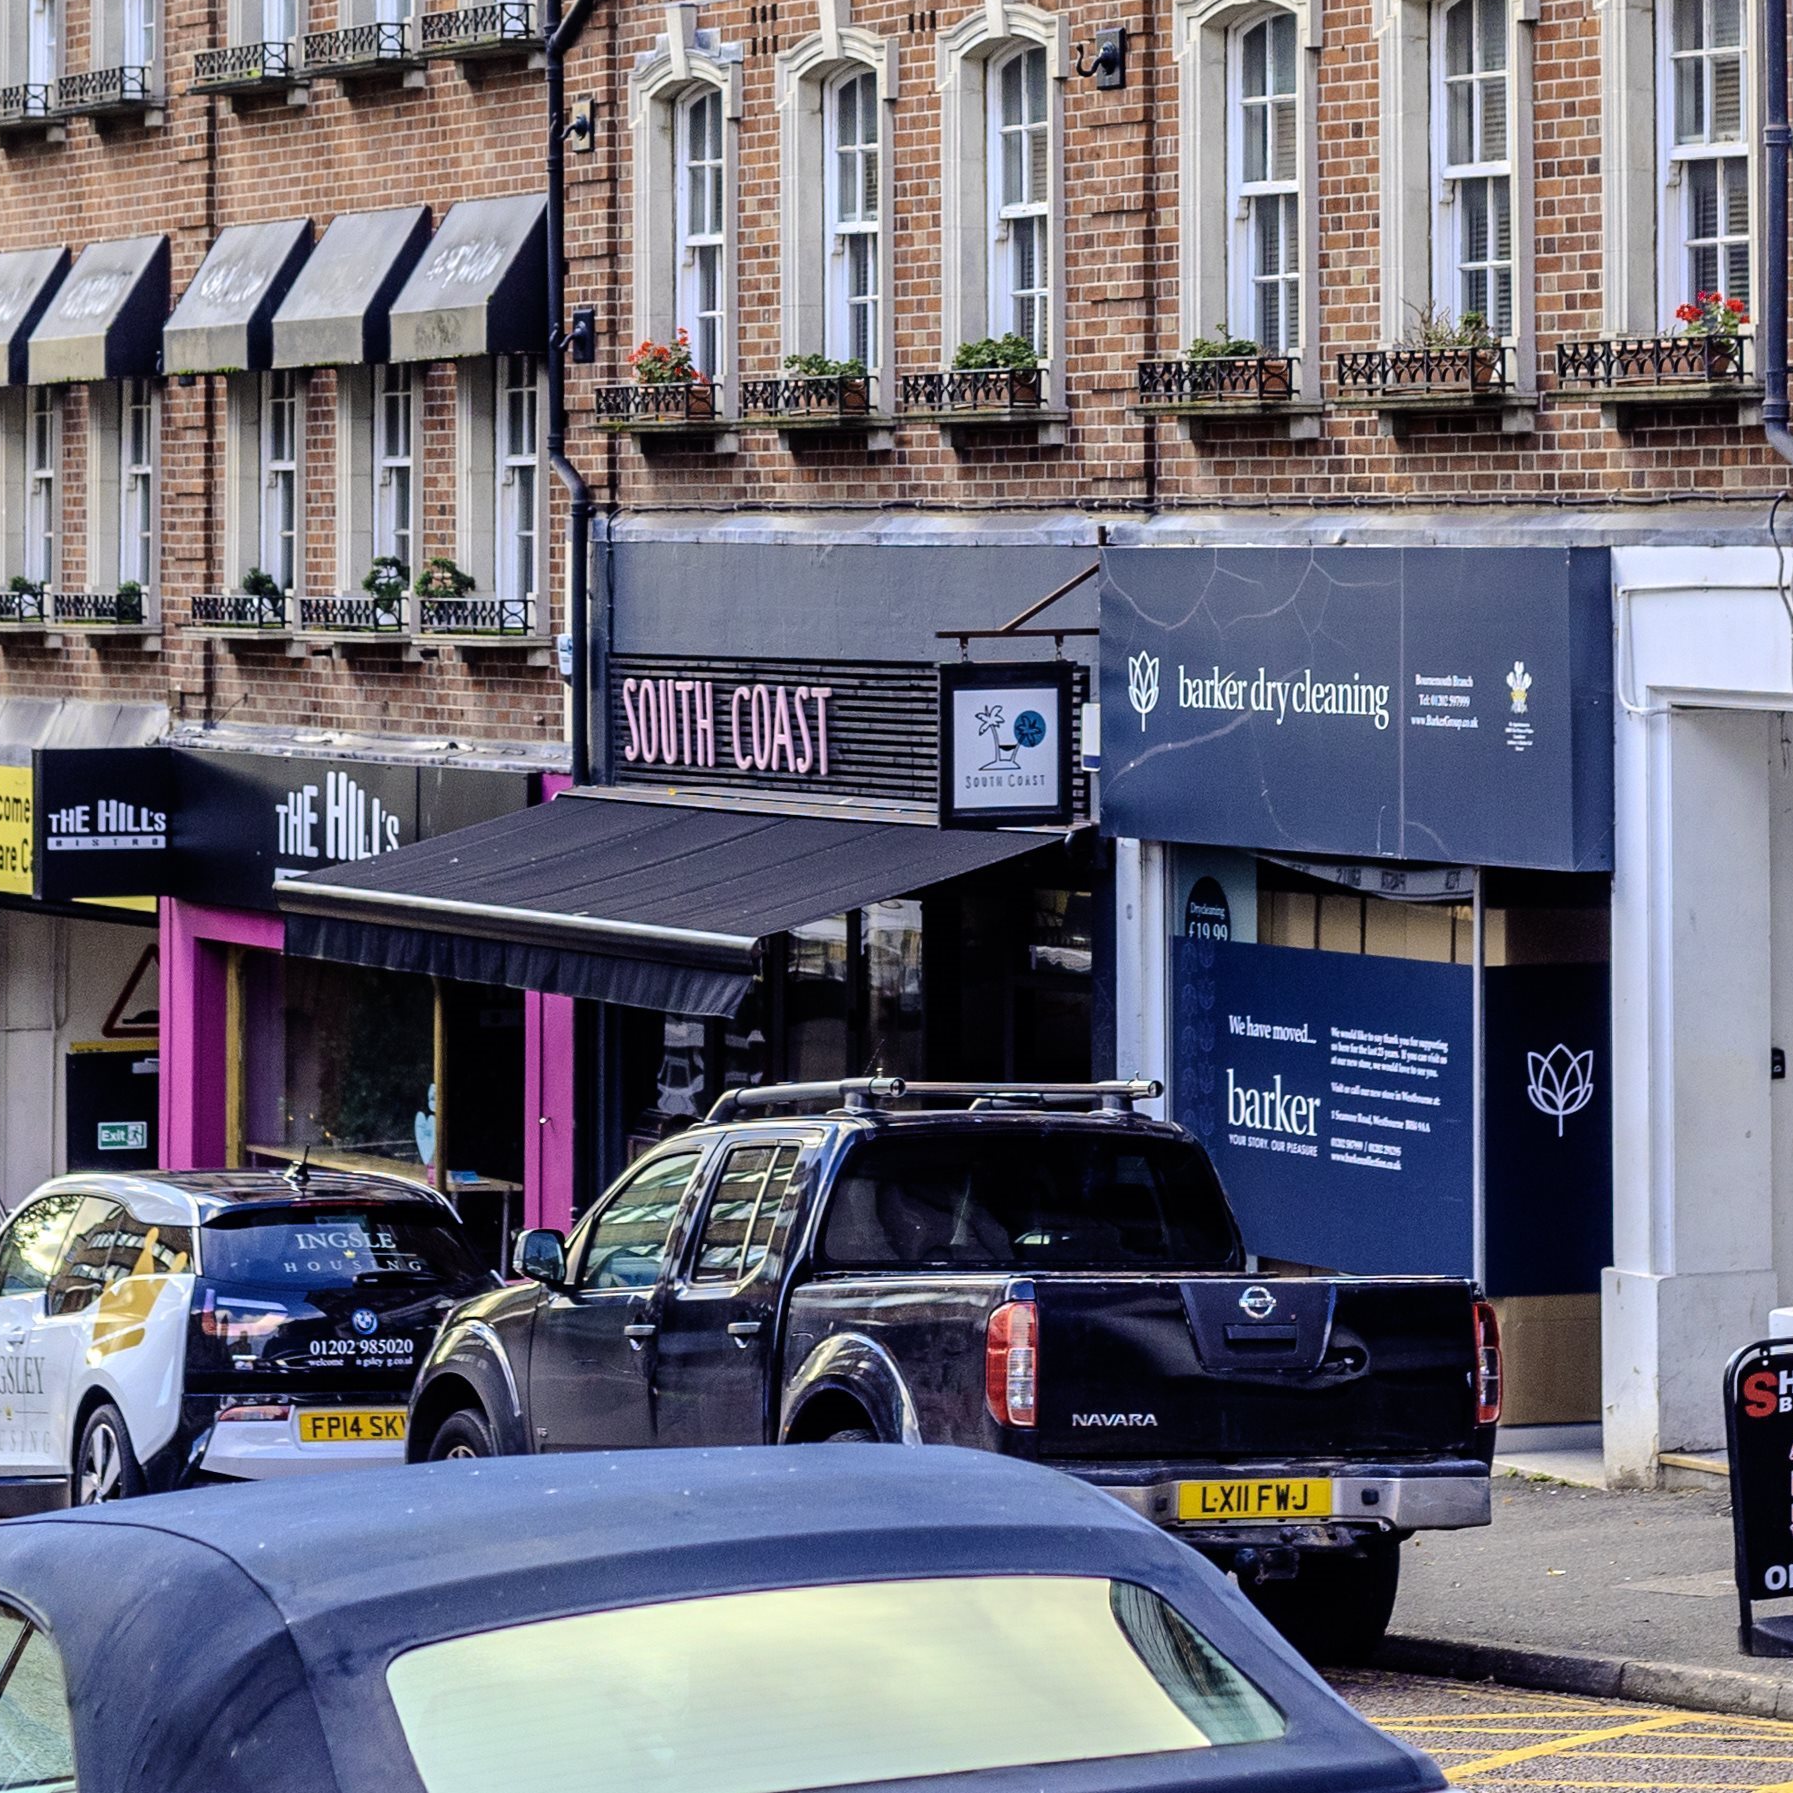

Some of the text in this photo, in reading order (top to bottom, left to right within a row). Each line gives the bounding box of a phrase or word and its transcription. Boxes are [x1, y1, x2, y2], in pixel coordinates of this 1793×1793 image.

[1178, 664, 1389, 730] barker dry cleaning
[622, 677, 833, 776] SOUTH COAST
[48, 805, 90, 834] THE
[275, 785, 319, 858] THE
[55, 839, 159, 847] BISTRO
[1228, 1014, 1246, 1036] We
[1246, 1015, 1272, 1039] have
[1226, 1068, 1321, 1137] barker
[101, 1129, 126, 1142] Exit
[1228, 1133, 1247, 1146] YOUR
[1270, 1139, 1286, 1152] OUR
[1286, 1142, 1319, 1158] PLEASURE
[283, 1259, 422, 1273] HOUSING
[309, 1339, 414, 1356] 01202 985020
[308, 1358, 344, 1367] welcome
[311, 1416, 363, 1438] FP14
[1072, 1413, 1158, 1427] NAVARA
[1257, 1483, 1309, 1511] FWJ
